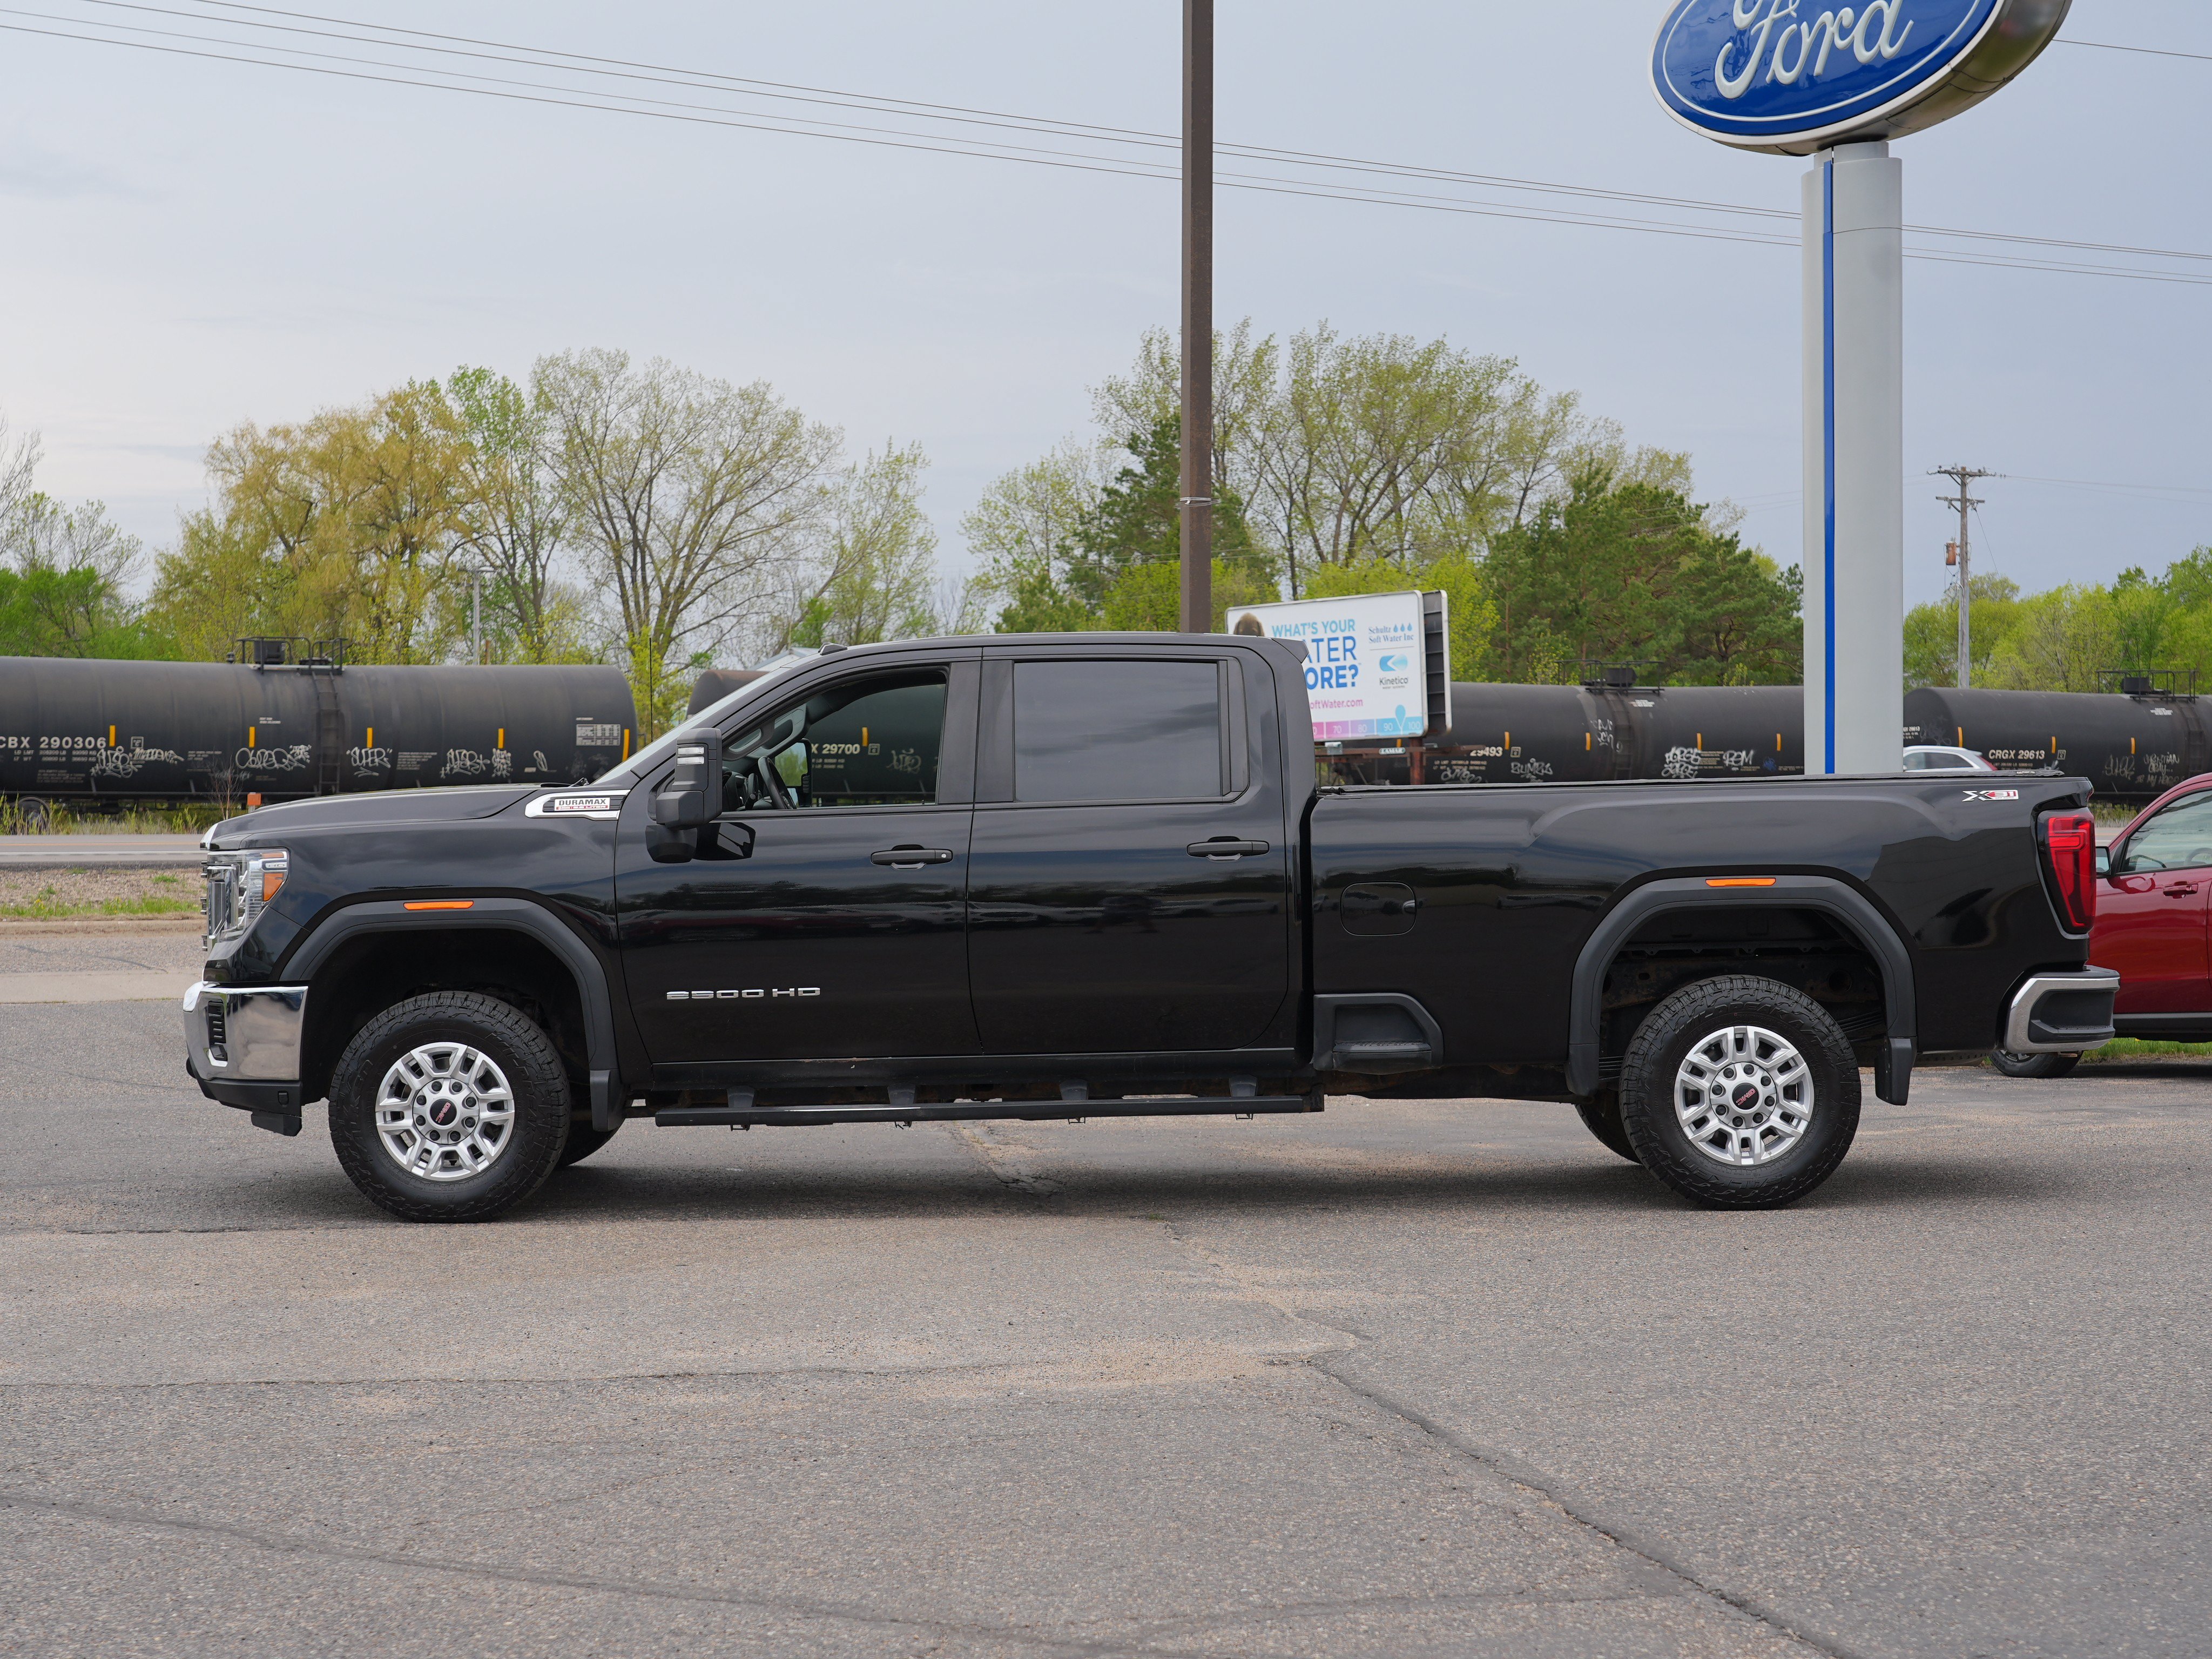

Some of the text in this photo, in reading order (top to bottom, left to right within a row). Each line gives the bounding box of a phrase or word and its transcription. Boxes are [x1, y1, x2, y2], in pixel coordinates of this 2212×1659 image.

[1714, 0, 1914, 99] Ford
[1272, 618, 1355, 637] WHAT'S YOUR
[1368, 626, 1391, 634] Schultz
[1379, 677, 1408, 685] Kinetico
[1333, 725, 1343, 733] 70
[1358, 724, 1367, 732] 80
[1383, 723, 1393, 731] 90
[1408, 721, 1421, 730] 100
[0, 736, 106, 749] CBX 290306
[822, 743, 861, 755] 29700
[1988, 749, 2015, 760] CRGX
[2018, 750, 2045, 760] 29613
[666, 987, 821, 1000] 2500 HD
[1736, 1088, 1756, 1105] GMC
[435, 1102, 451, 1123] GMC
